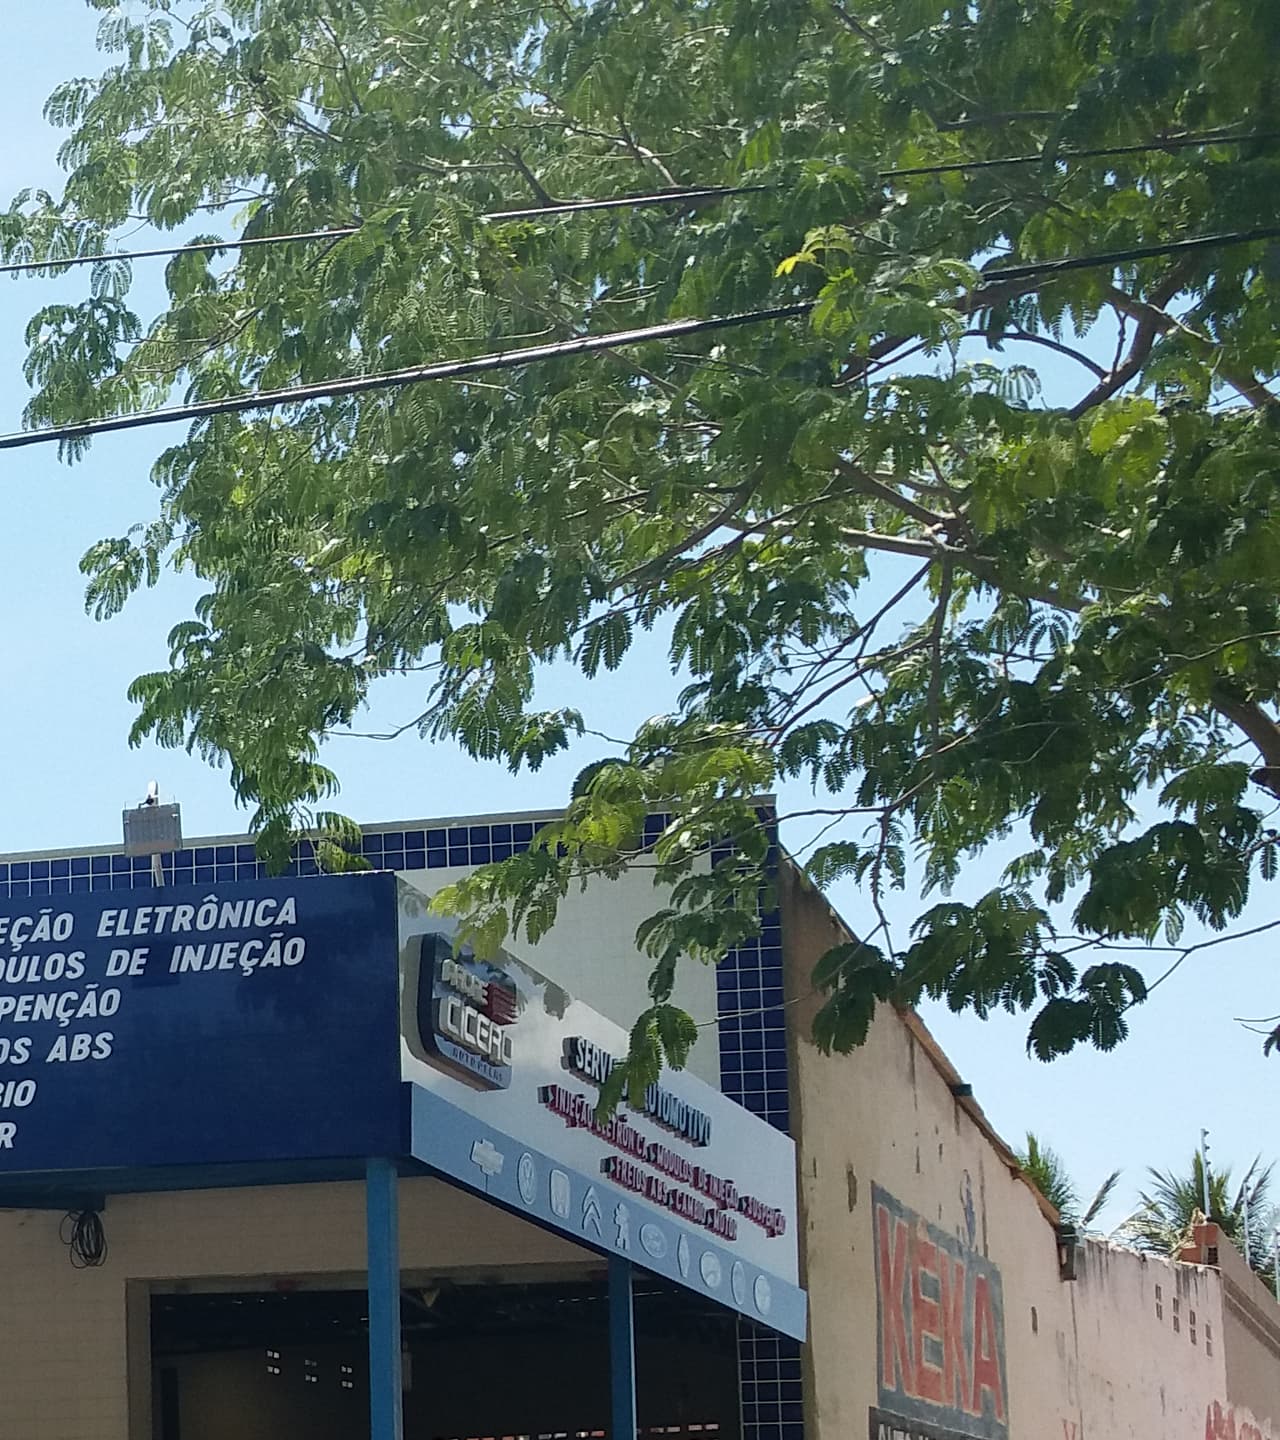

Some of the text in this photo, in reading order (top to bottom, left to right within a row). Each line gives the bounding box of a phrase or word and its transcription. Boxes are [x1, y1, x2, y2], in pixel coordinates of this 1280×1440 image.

[96, 894, 297, 938] ELETRÔNICA
[106, 948, 147, 977] DE
[169, 936, 306, 978] INJEÇÃO
[46, 1032, 114, 1063] ABS
[642, 1080, 712, 1147] UTOMOTIVO
[876, 1203, 1007, 1425] KEKA
